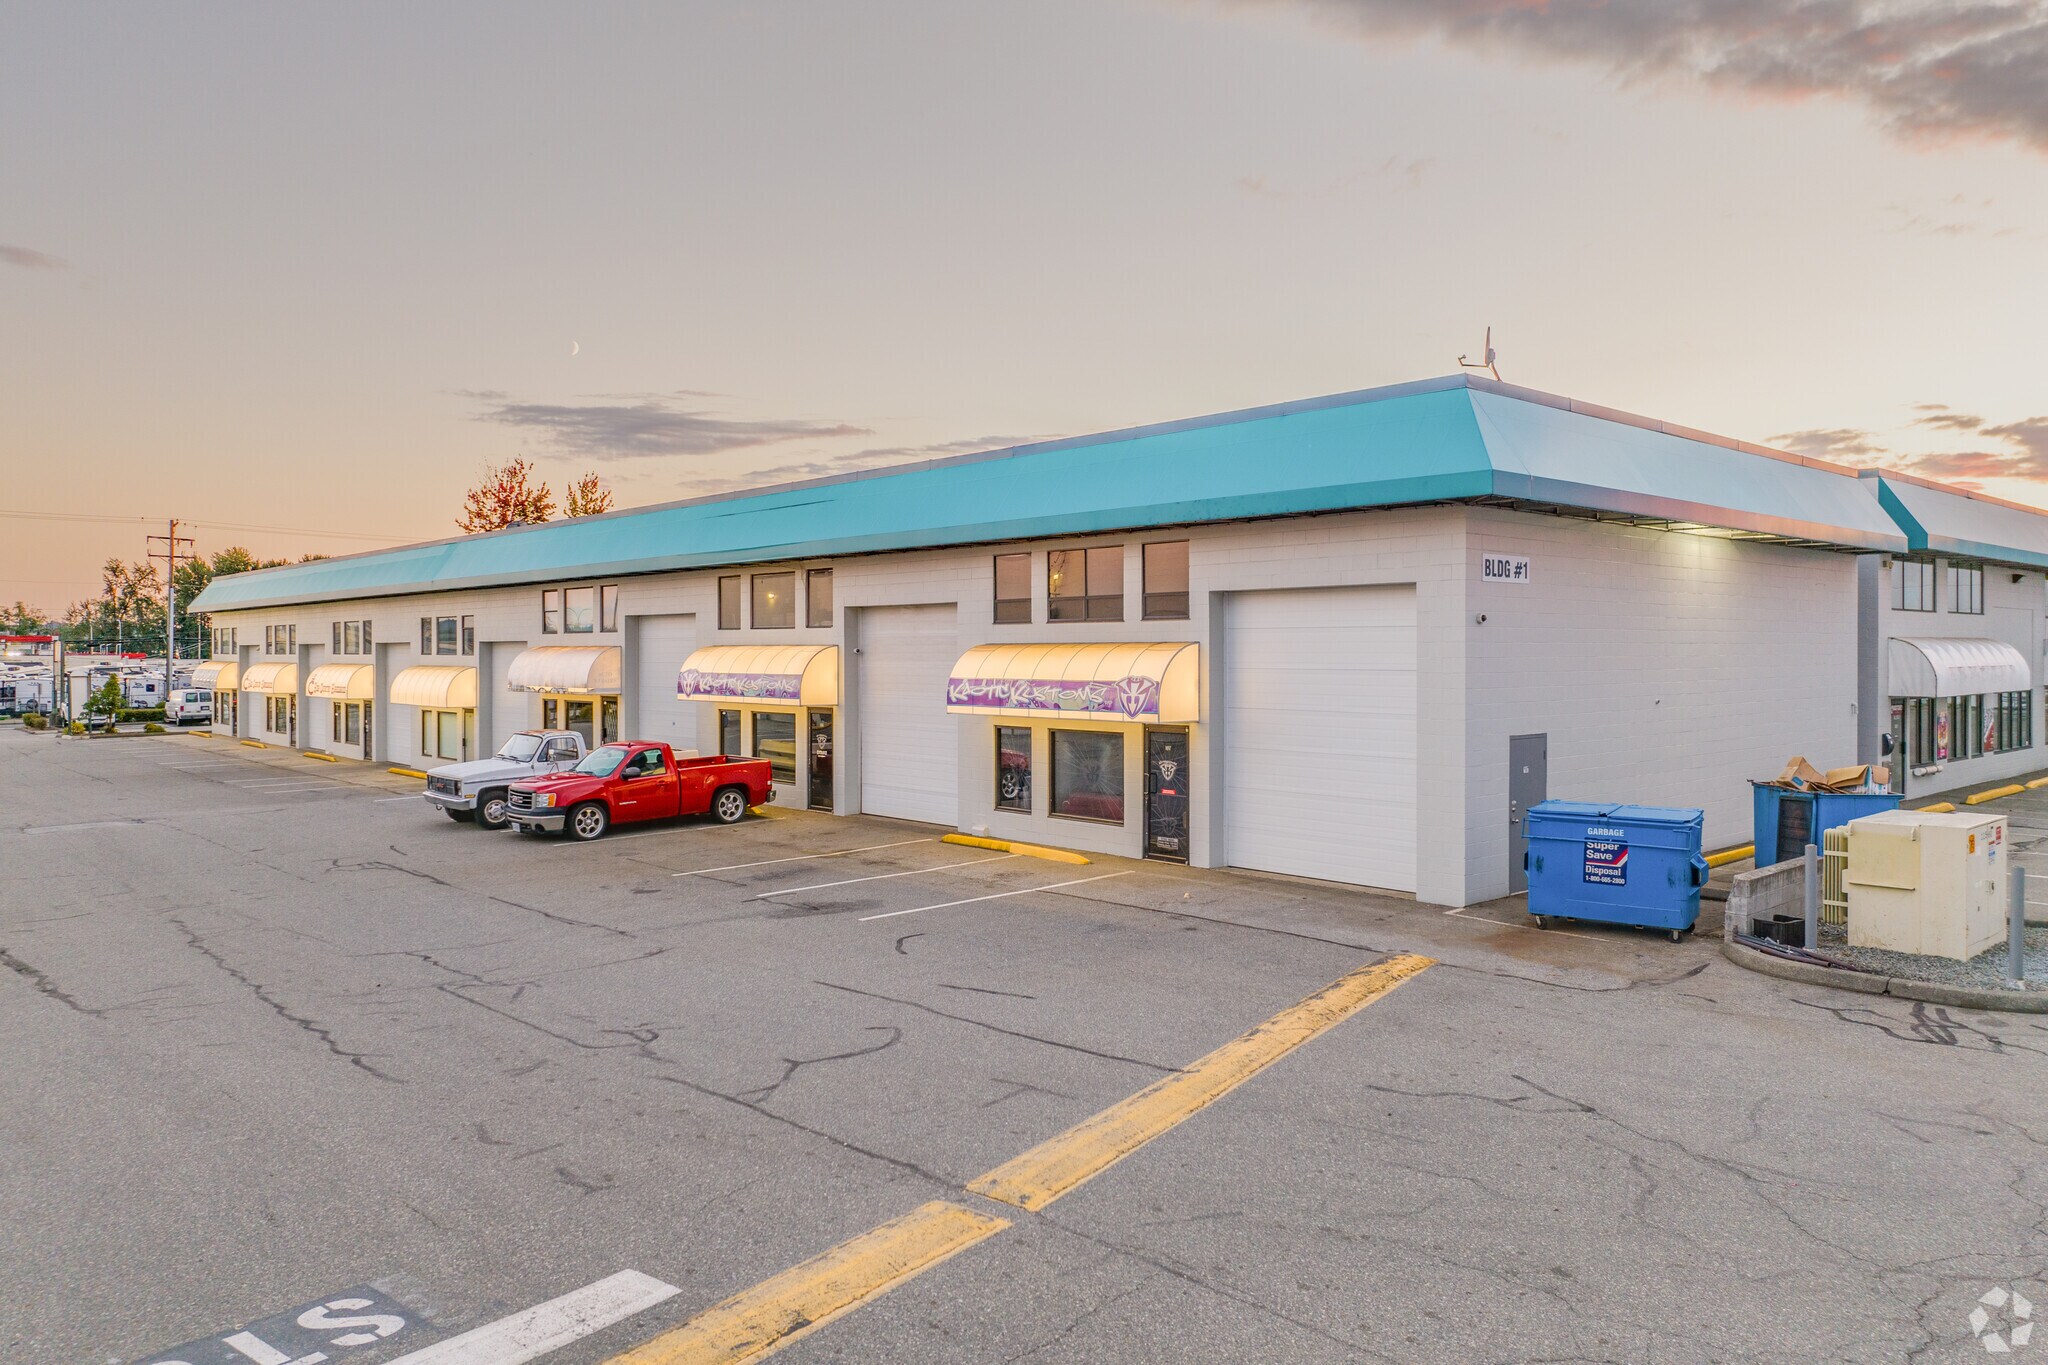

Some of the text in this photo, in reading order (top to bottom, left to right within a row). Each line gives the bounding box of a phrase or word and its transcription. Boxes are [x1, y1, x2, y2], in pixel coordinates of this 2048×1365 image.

[1485, 559, 1528, 579] BLDG #1
[1587, 827, 1624, 837] GARBAGE
[1587, 841, 1619, 850] Super
[1586, 849, 1613, 860] Save
[1585, 865, 1621, 876] Disposal
[1585, 875, 1625, 884] 1-800-665-2800
[150, 1298, 406, 1365] LS
